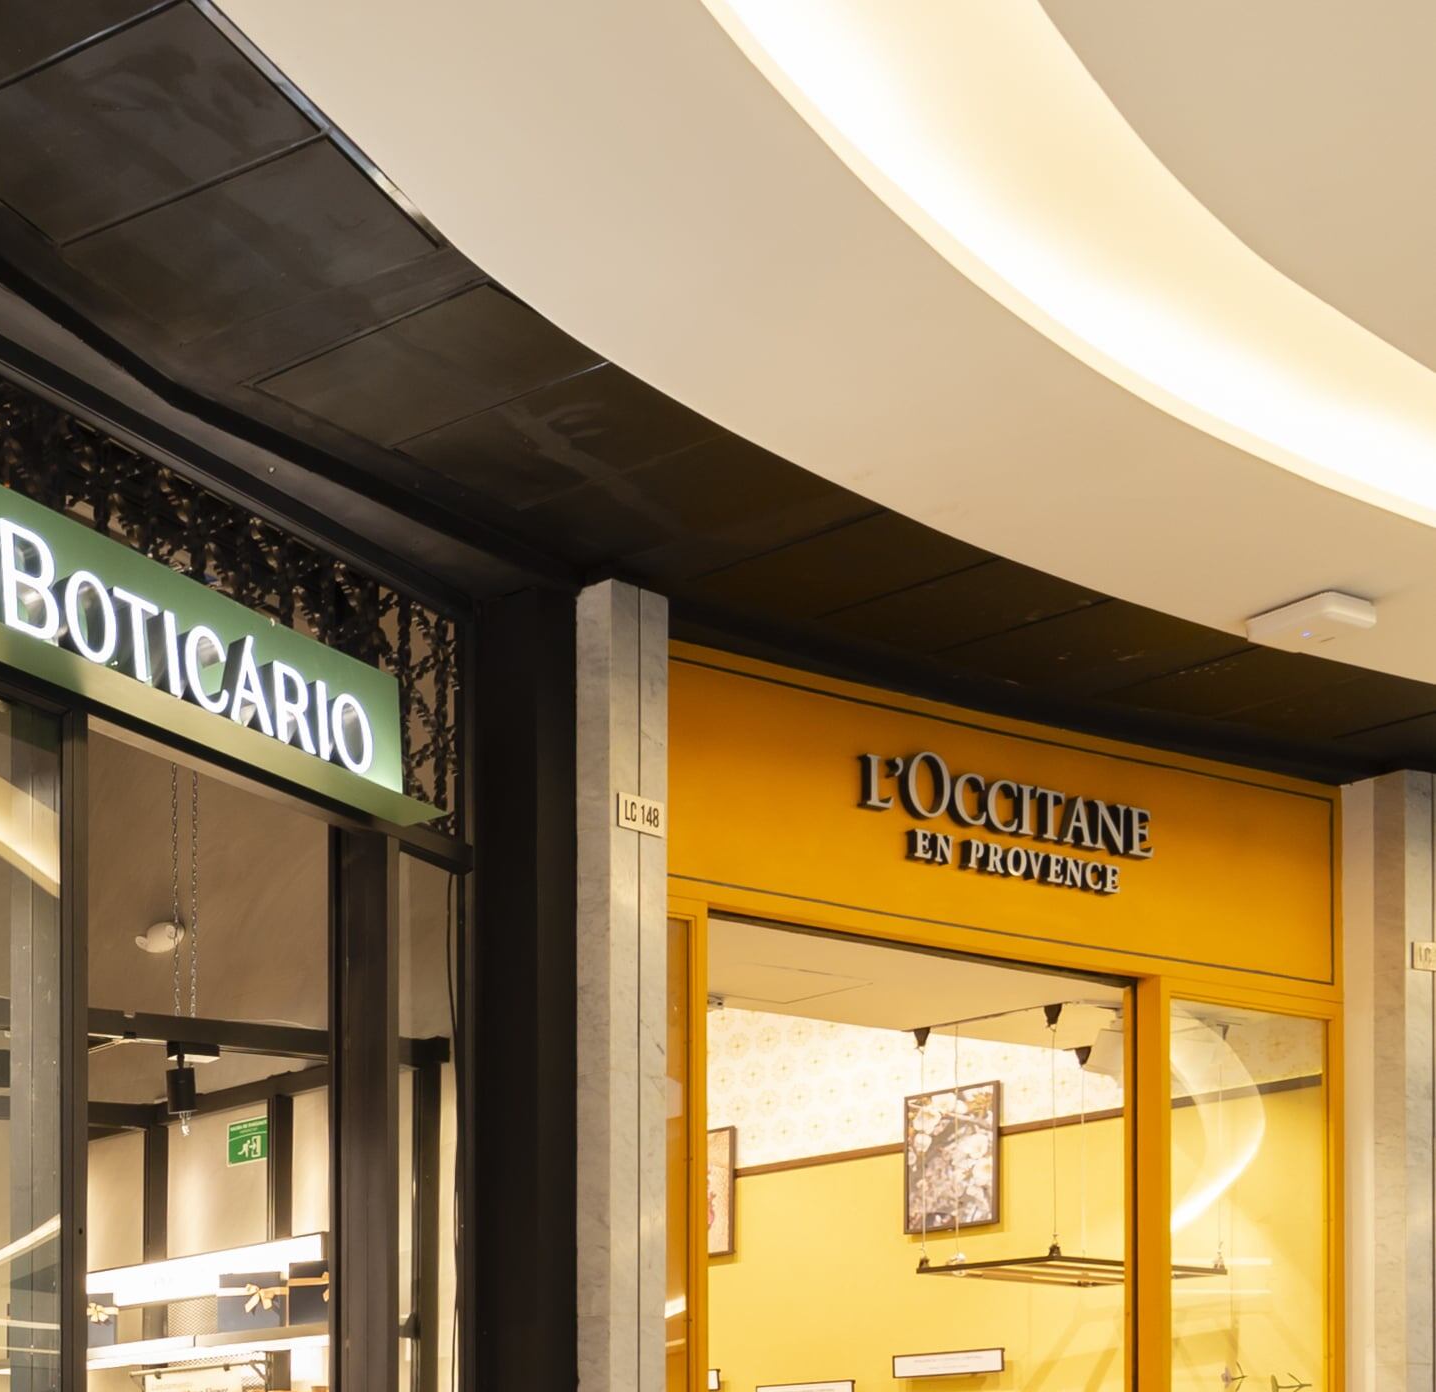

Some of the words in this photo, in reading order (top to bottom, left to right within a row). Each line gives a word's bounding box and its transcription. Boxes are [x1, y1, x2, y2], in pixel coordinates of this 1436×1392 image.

[624, 799, 637, 822] LC
[640, 804, 660, 829] 148
[861, 750, 1154, 860] L'OCCITANE
[912, 827, 953, 865] EN
[965, 840, 1120, 895] PROVENCE
